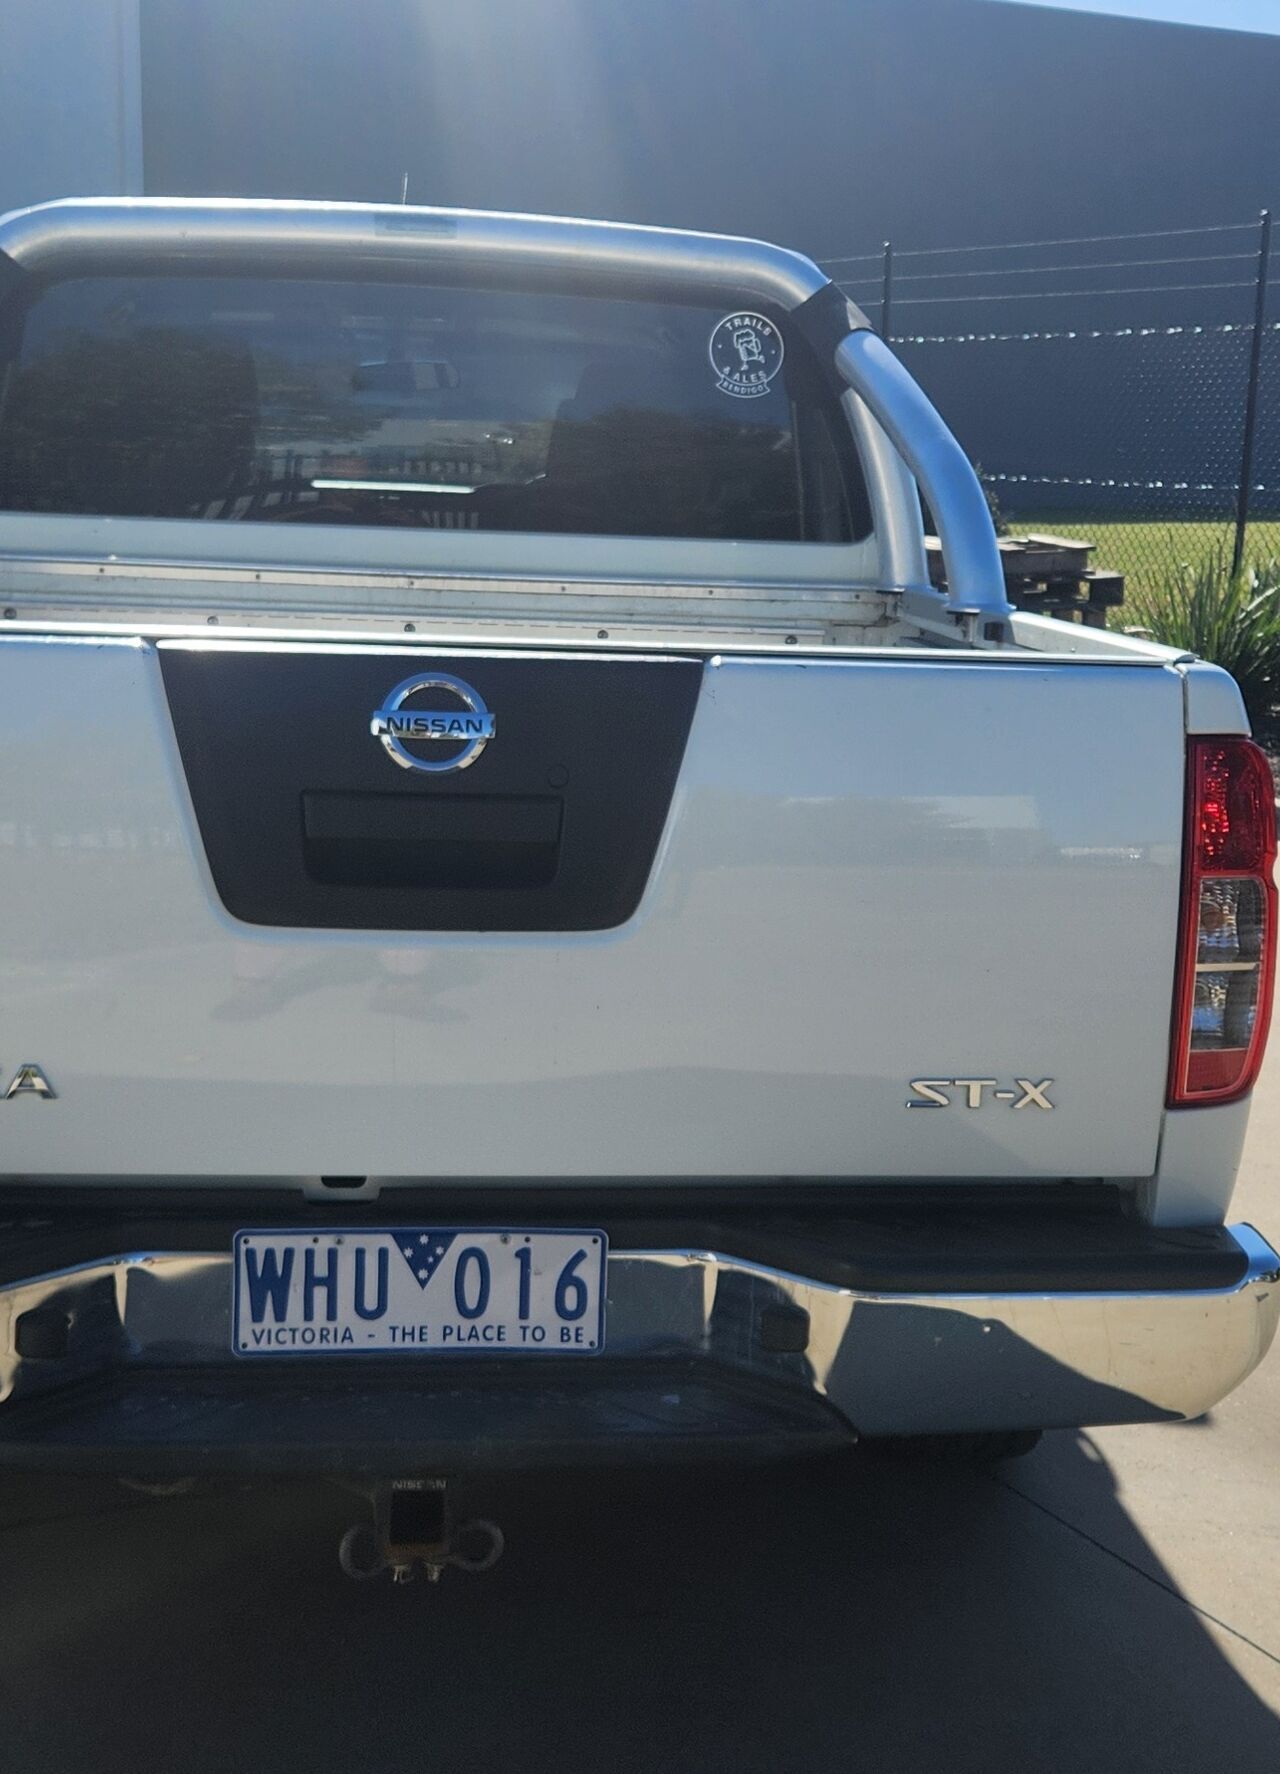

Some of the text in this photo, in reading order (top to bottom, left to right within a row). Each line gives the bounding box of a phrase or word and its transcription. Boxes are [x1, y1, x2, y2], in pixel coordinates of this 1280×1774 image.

[725, 317, 772, 336] TRAILS
[732, 370, 766, 384] ALES
[722, 381, 763, 395] BENDIGO
[386, 716, 483, 733] NISSAN
[905, 1078, 1055, 1109] ST-X
[245, 1246, 589, 1323] WHU 016
[251, 1326, 354, 1345] VICTORIA
[389, 1325, 428, 1343] THE
[442, 1324, 507, 1343] PLACE
[520, 1325, 546, 1343] TO
[560, 1325, 585, 1344] BE
